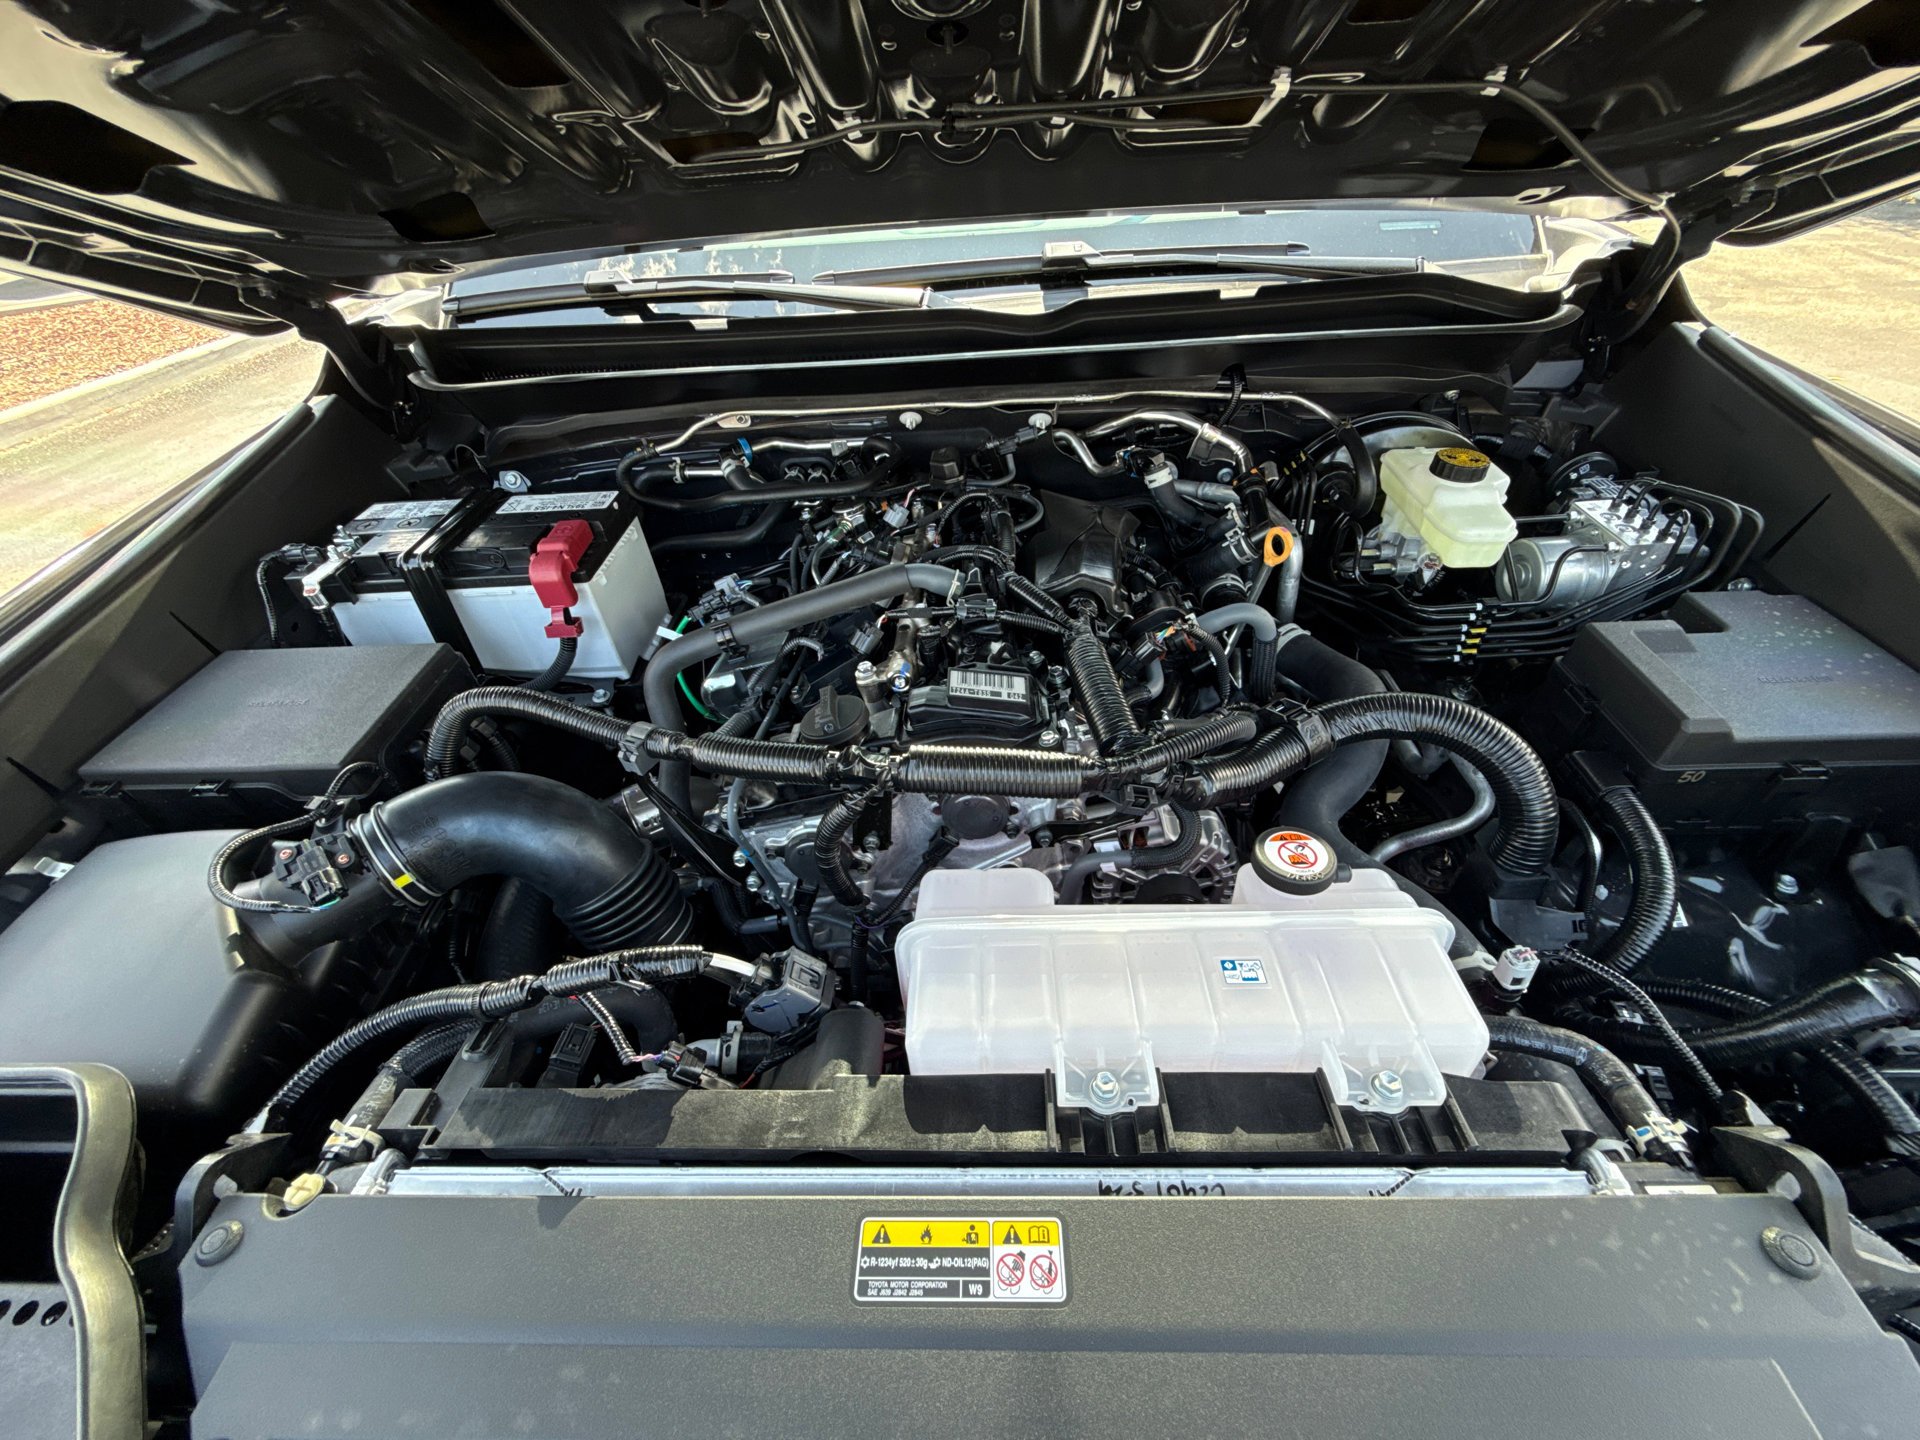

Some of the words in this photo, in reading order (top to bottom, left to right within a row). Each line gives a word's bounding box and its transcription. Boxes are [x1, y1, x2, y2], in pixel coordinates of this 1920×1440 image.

[1677, 770, 1707, 783] 50
[870, 1257, 899, 1268] R-1234yf
[942, 1257, 989, 1269] ND-OIL12(PAG)
[910, 1281, 948, 1289] CORPORATION
[968, 1283, 983, 1295] W9
